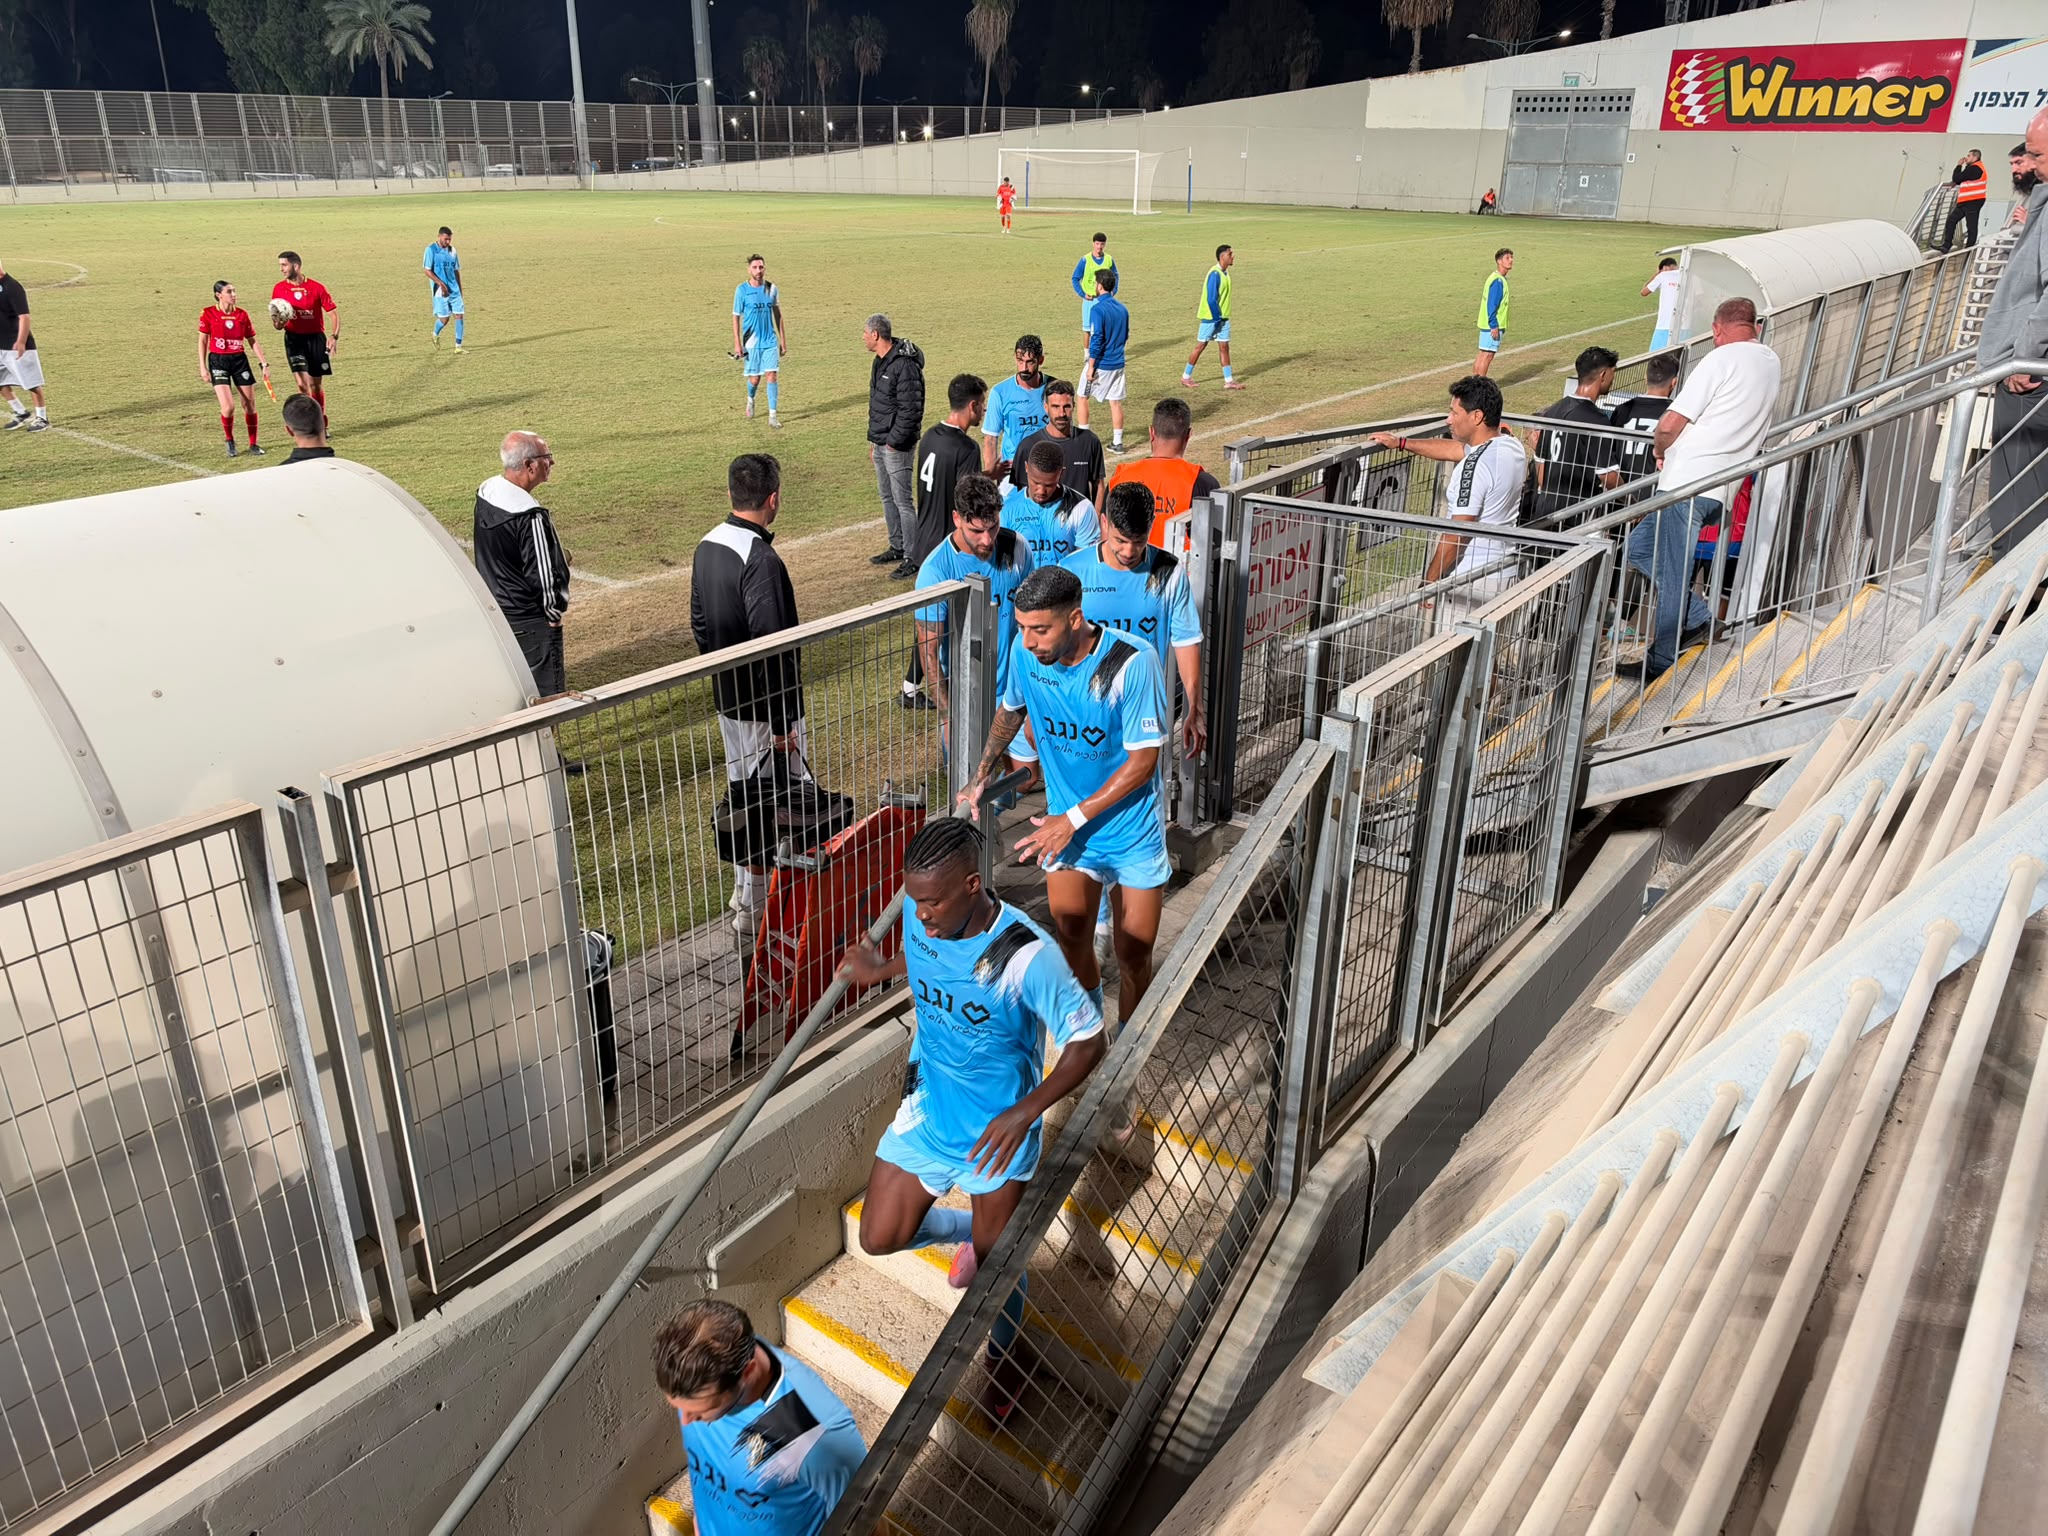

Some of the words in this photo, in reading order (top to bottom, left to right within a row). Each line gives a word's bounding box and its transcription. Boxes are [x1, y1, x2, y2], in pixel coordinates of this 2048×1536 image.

[1728, 61, 1946, 119] Winner
[1964, 90, 2030, 113] הצפון.
[2033, 88, 2048, 108] ל
[1550, 427, 1563, 461] 6
[1623, 417, 1660, 455] 17
[920, 452, 936, 492] 4
[1249, 538, 1312, 598] אסורה
[1043, 715, 1079, 741] נגב
[911, 933, 939, 960] GIVOVA
[917, 978, 954, 1014] נגב
